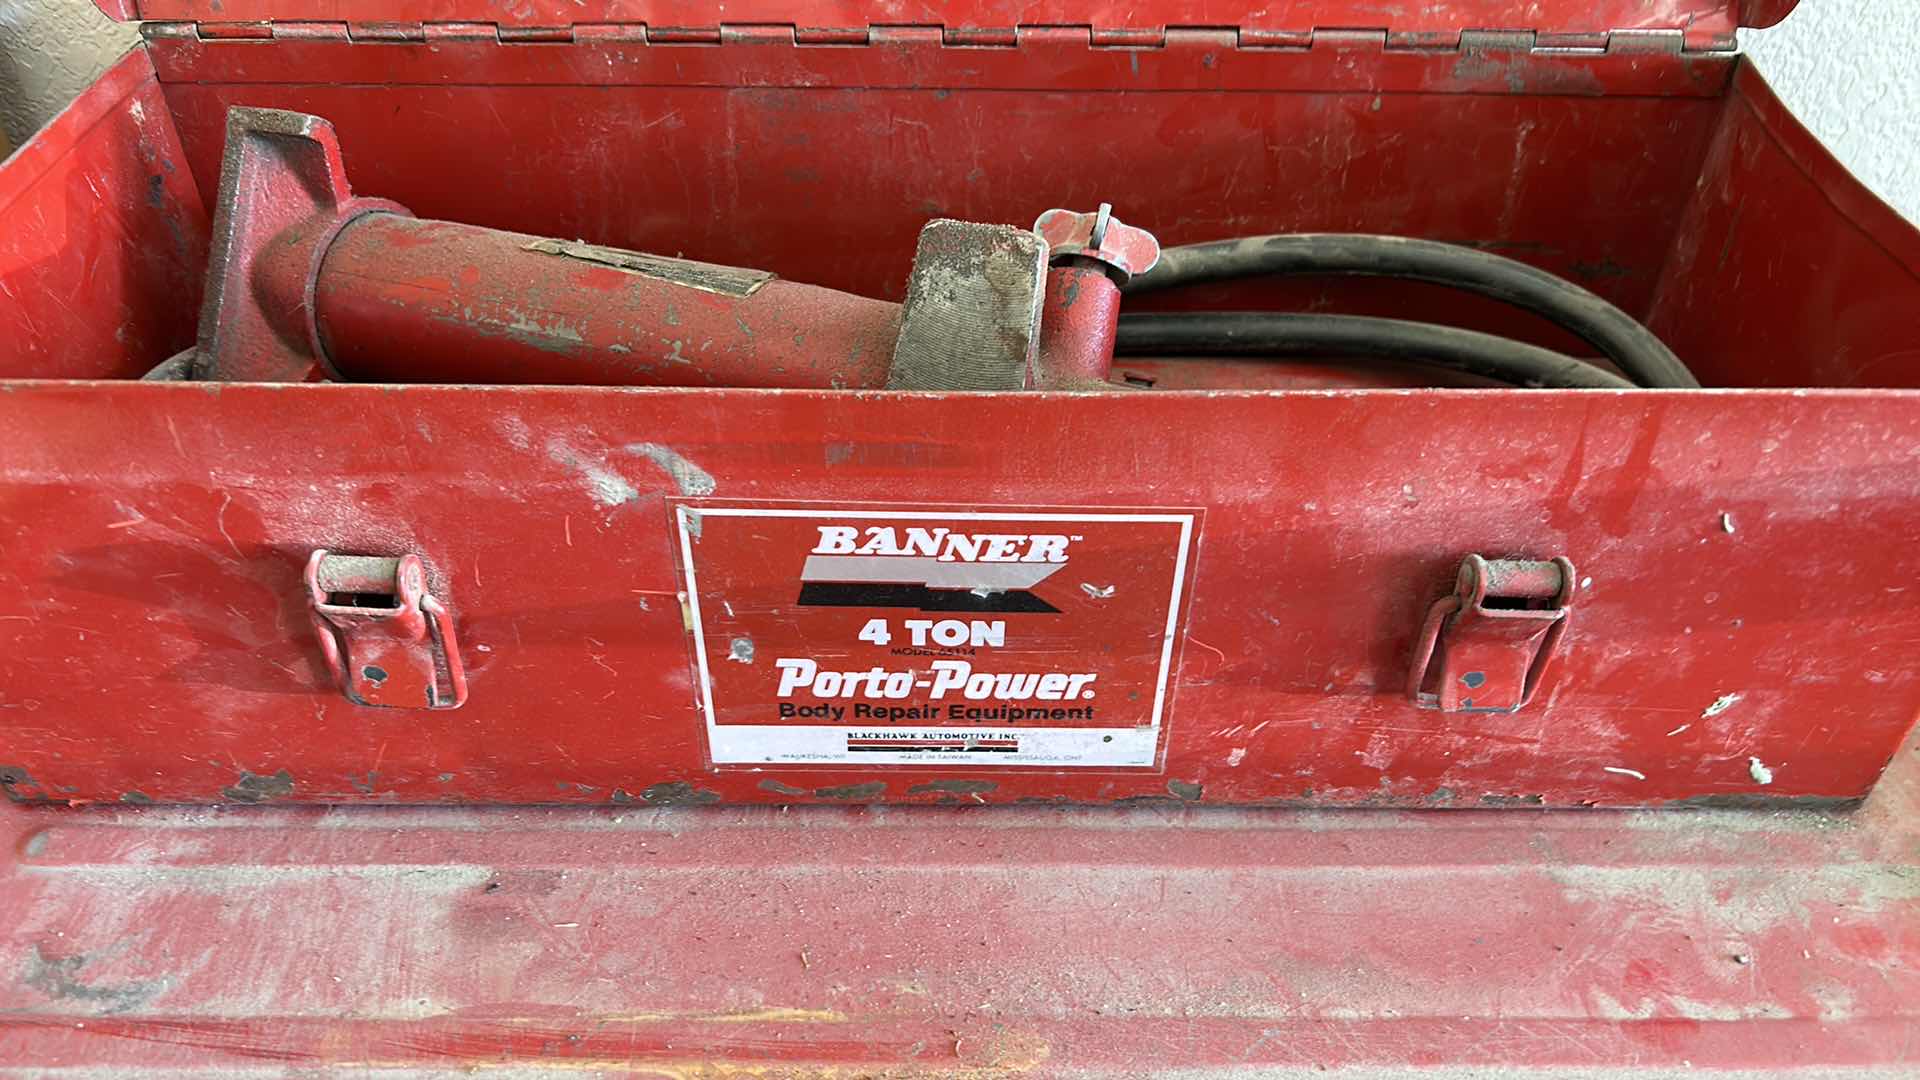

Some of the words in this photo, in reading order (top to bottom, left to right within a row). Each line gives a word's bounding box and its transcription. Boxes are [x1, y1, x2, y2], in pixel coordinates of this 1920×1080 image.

[858, 618, 891, 646] 4
[904, 619, 1006, 647] TON
[890, 647, 936, 656] MODEL
[779, 702, 845, 722] Body
[854, 703, 940, 722] Repair
[948, 703, 1093, 724] Equipment
[847, 732, 919, 740] BLACKHAWK
[922, 732, 993, 740] AUTOMOTIVE
